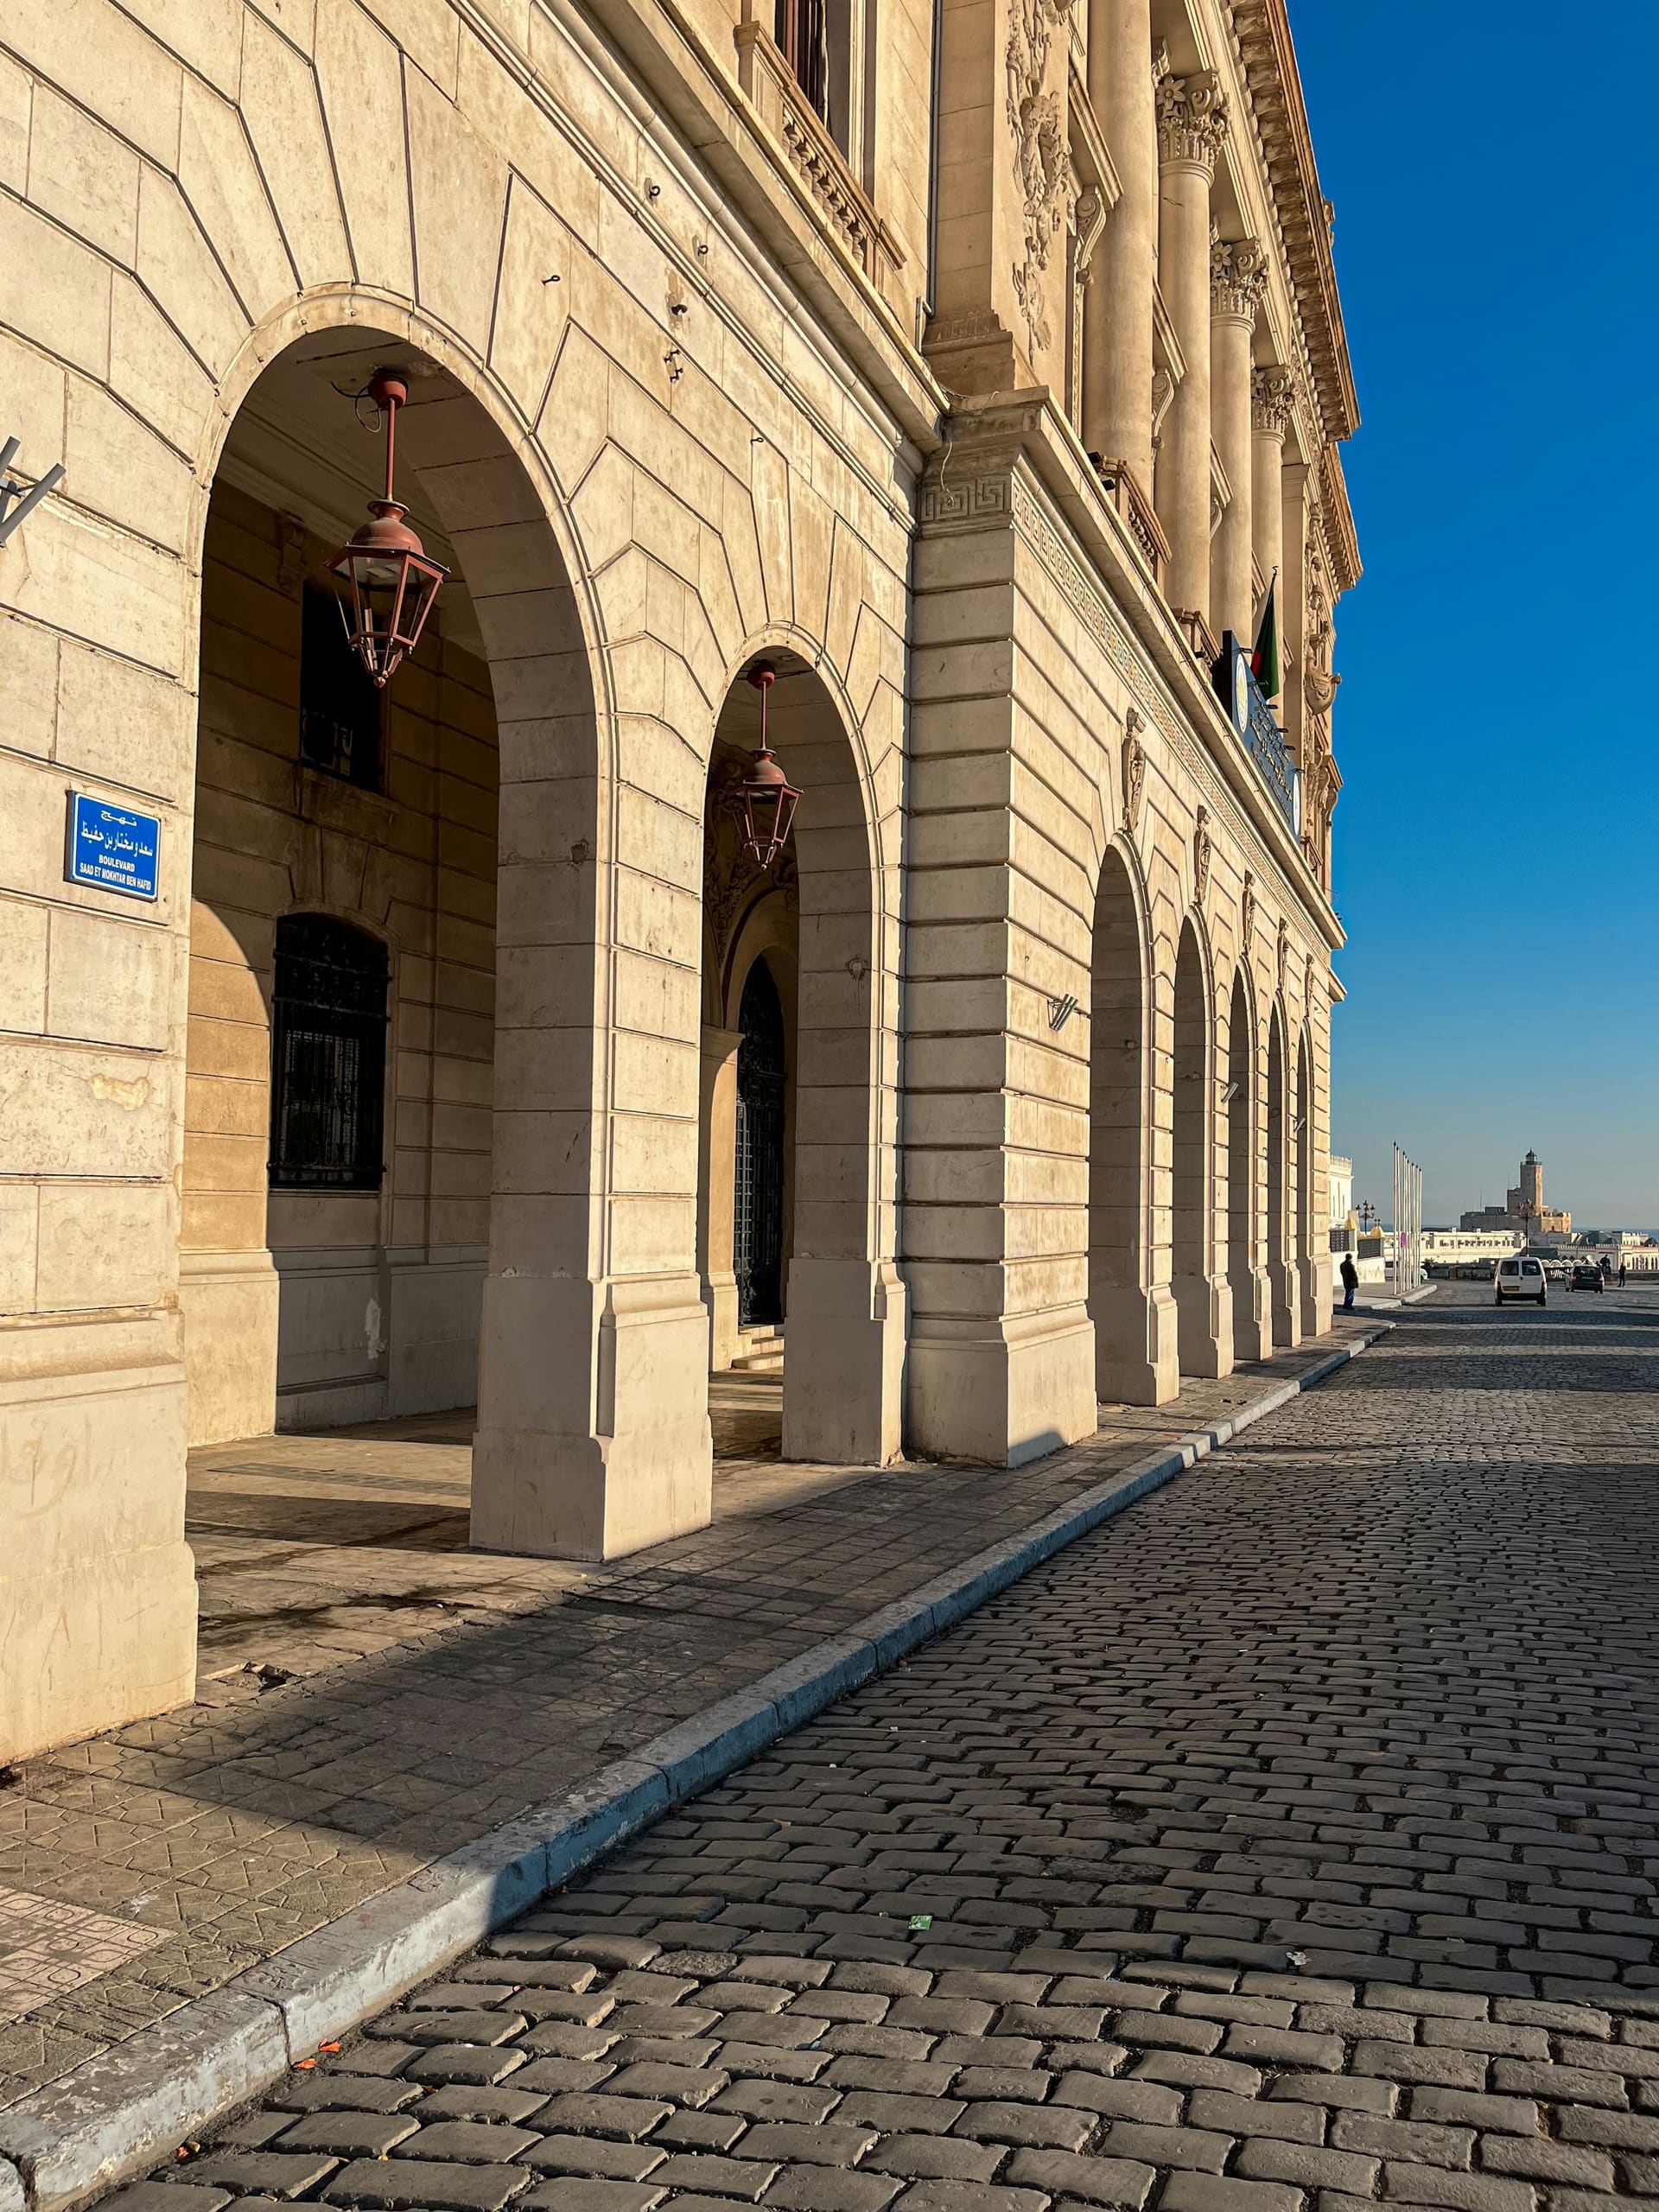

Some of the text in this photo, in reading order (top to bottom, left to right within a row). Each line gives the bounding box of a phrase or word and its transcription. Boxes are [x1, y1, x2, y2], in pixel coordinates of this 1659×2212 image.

[81, 821, 105, 844] حفيظ
[138, 842, 153, 856] سعد
[99, 854, 136, 873] BOULEVARD
[79, 862, 152, 891] SAAD ET MOKHTAR BEN HAFID
